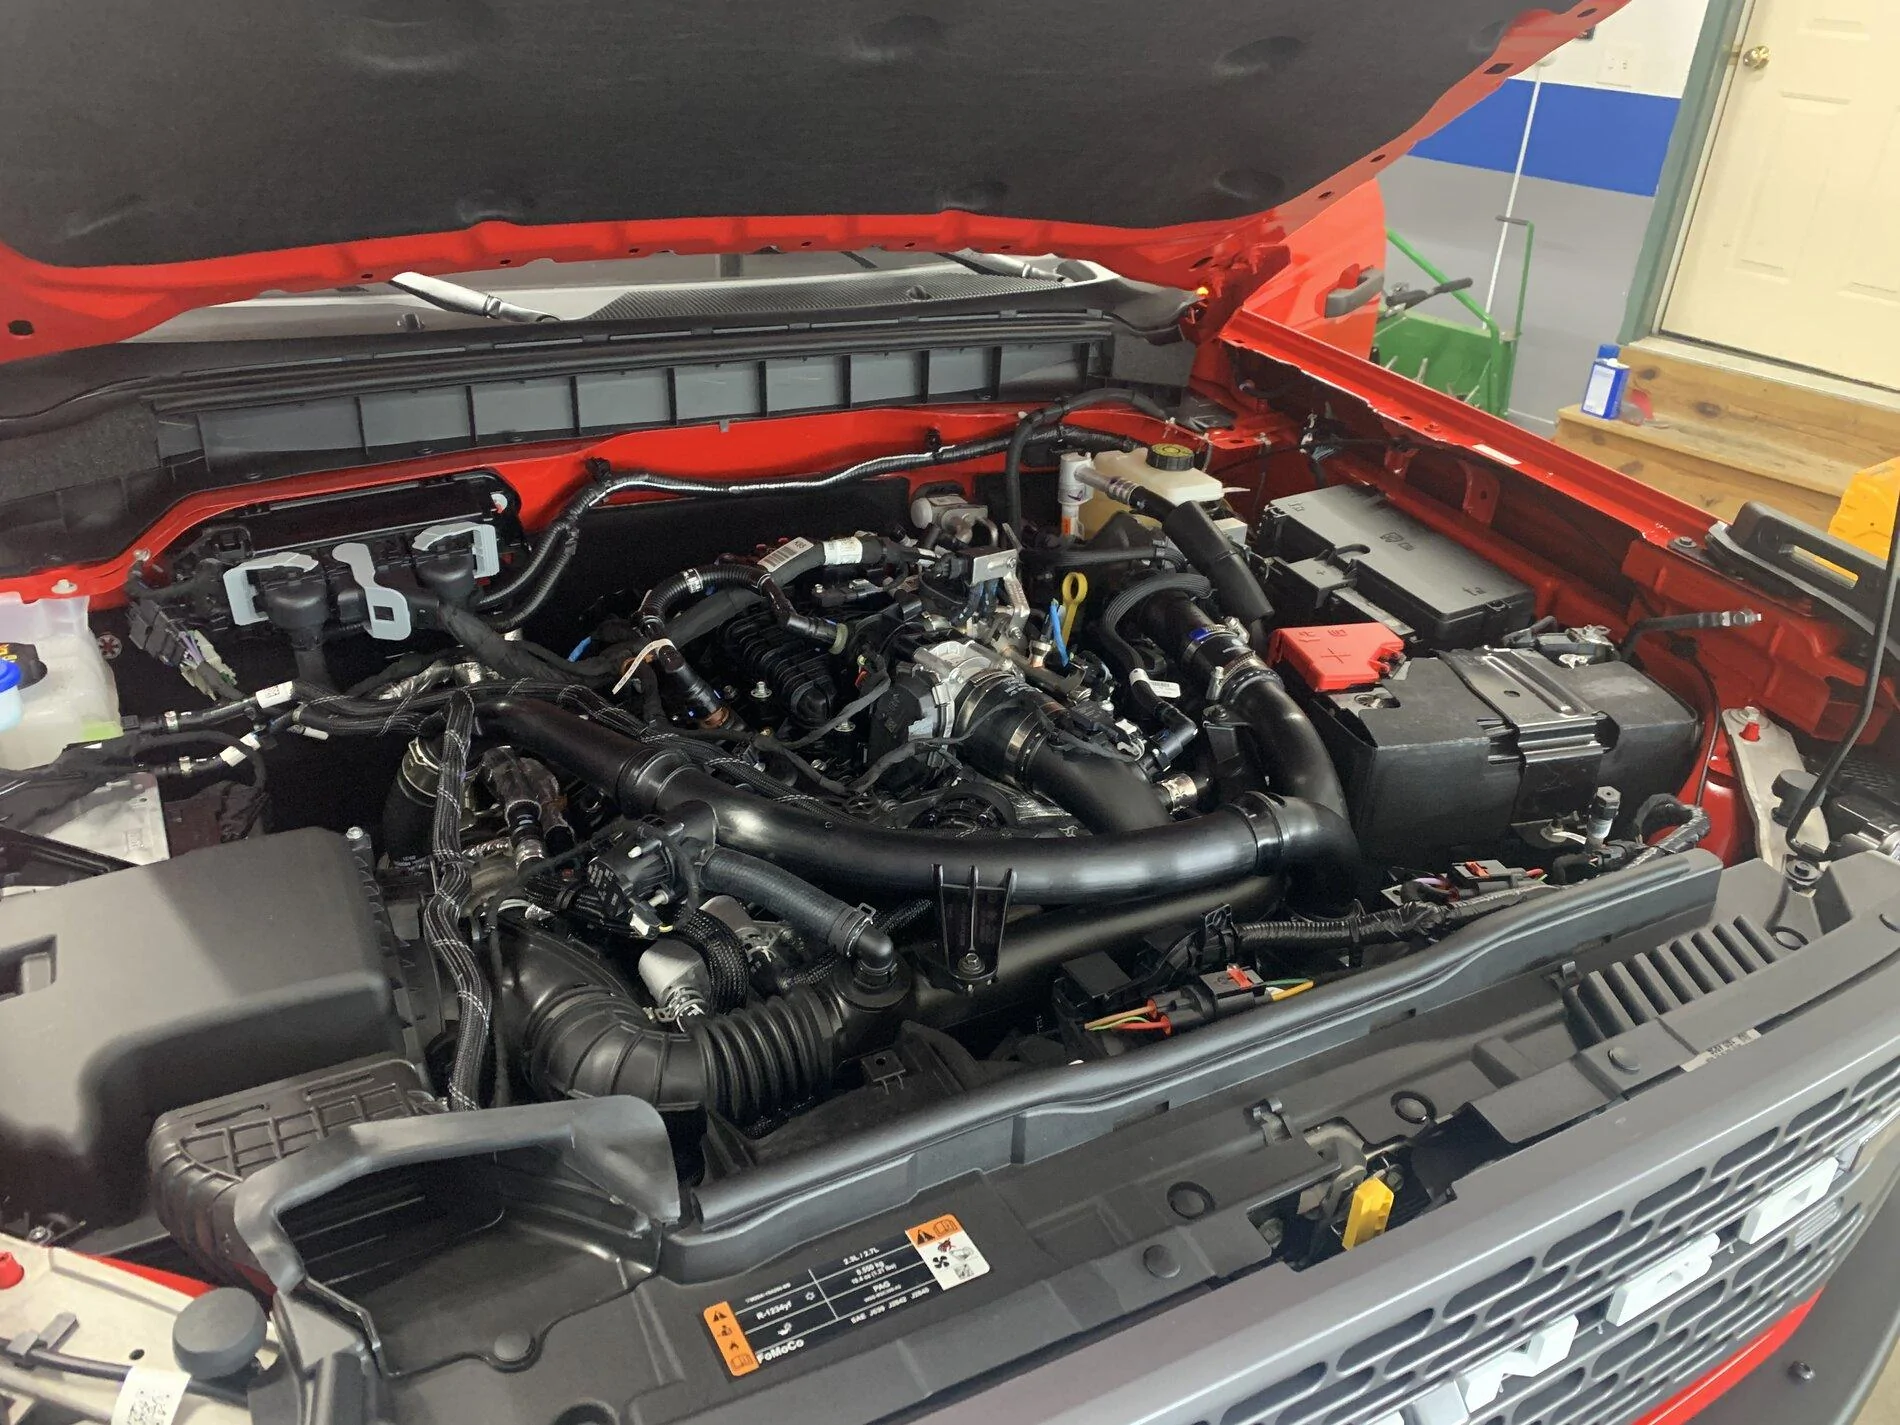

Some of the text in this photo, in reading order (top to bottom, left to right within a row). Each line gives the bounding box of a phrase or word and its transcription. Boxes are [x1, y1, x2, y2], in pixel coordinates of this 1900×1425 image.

[863, 1247, 880, 1258] 2.7L
[872, 1280, 891, 1293] PAG
[756, 1300, 792, 1320] R-1234yf
[850, 1312, 867, 1325] SAE
[756, 1339, 805, 1364] FoMoCo
